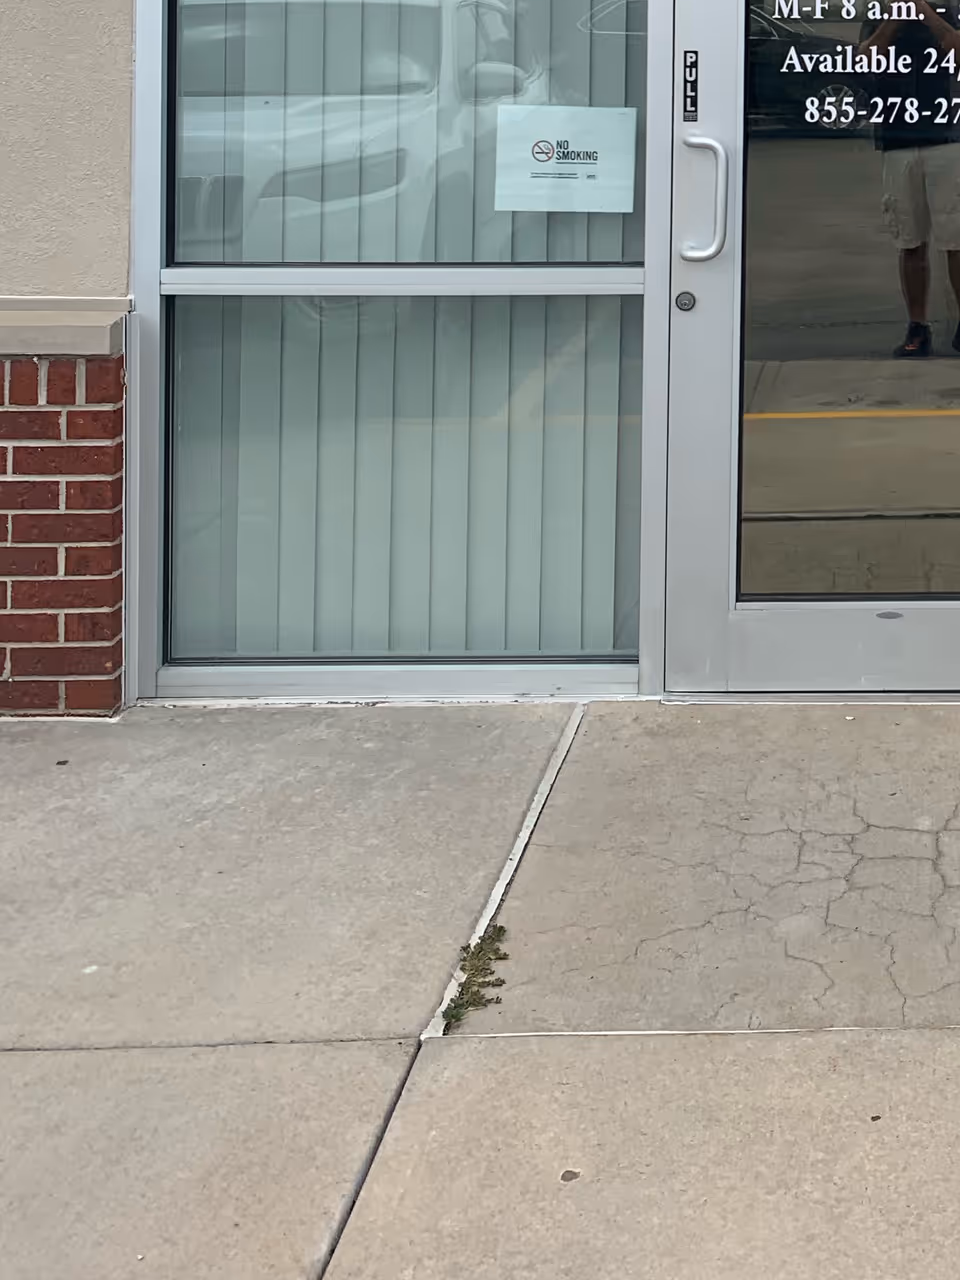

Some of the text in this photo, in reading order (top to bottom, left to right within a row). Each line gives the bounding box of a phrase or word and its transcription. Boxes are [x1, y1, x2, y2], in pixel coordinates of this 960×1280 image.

[867, 1, 926, 21] a.m.
[780, 44, 912, 74] Available
[685, 52, 697, 111] PULL
[556, 140, 569, 150] NO
[555, 150, 598, 161] SMOKING
